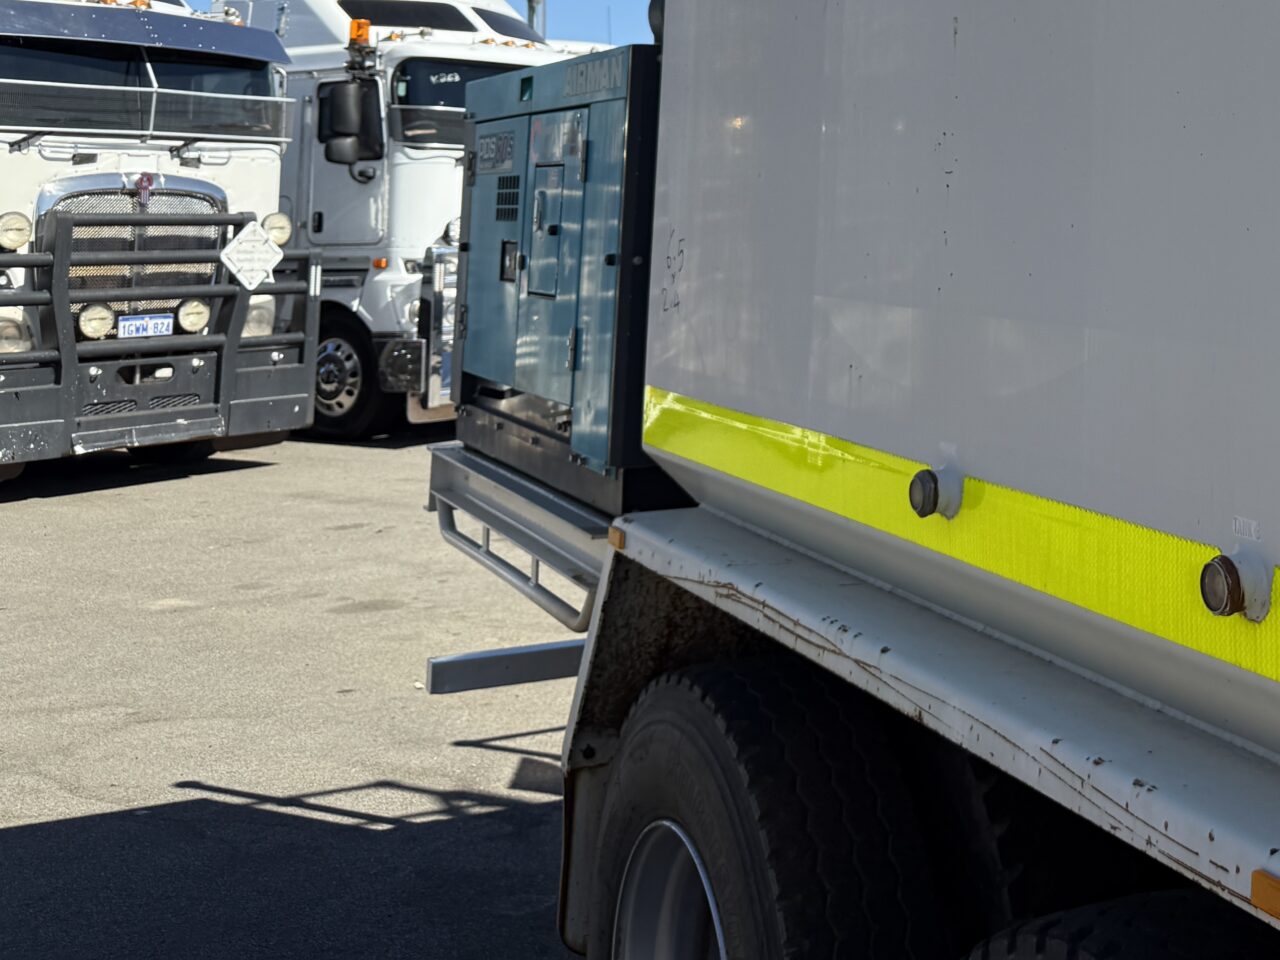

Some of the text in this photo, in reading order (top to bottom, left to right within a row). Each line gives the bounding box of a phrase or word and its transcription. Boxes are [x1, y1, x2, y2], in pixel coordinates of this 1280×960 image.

[564, 52, 624, 97] AIRMAN
[122, 321, 170, 336] 1GWM 824
